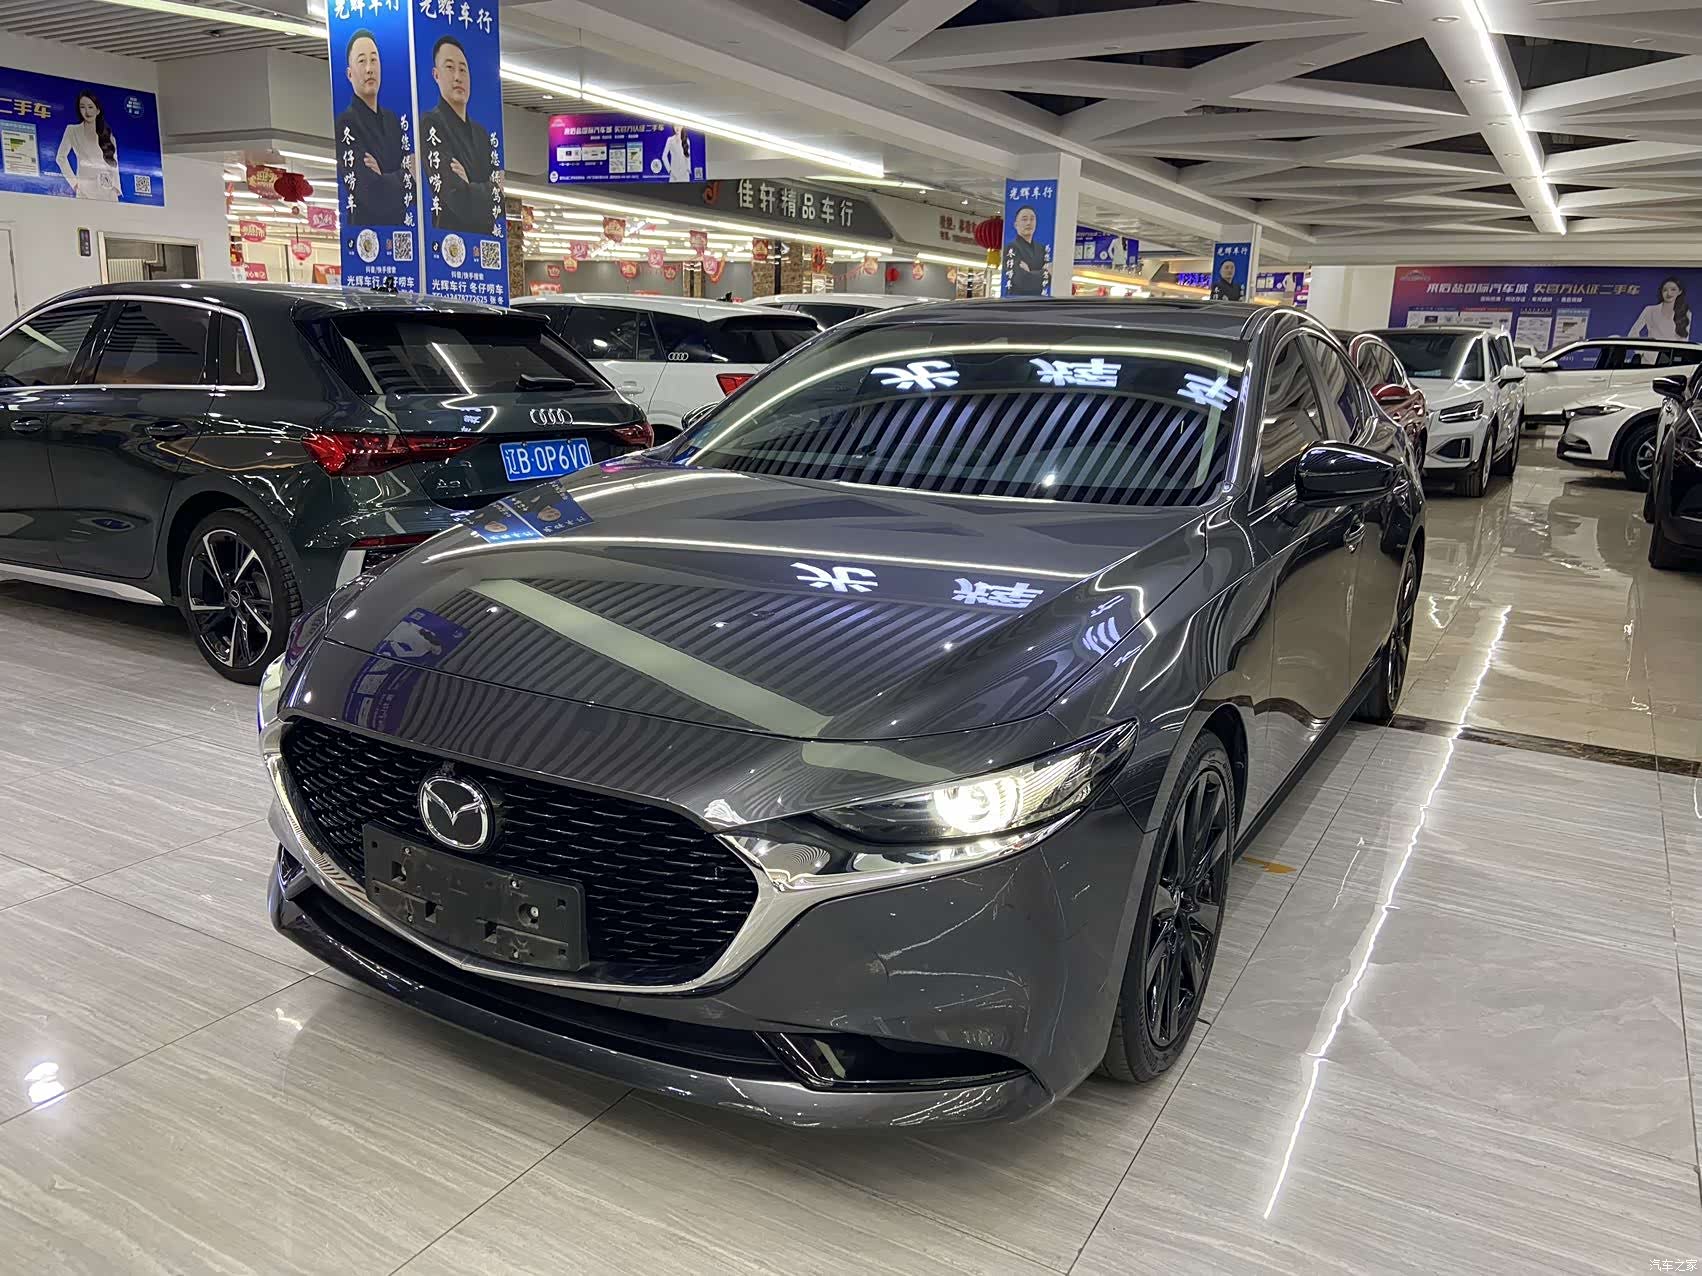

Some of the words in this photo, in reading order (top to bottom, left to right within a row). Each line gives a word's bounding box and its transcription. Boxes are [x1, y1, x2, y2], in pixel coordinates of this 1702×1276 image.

[0, 97, 52, 119] 二手车
[400, 114, 416, 227] 为您保驾护航
[490, 132, 504, 239] 为您保驾护航
[1009, 186, 1053, 200] 光辉车行
[737, 178, 853, 227] 佳轩精品车行
[347, 275, 380, 288] 光辉车行
[432, 279, 467, 293] 光辉车行
